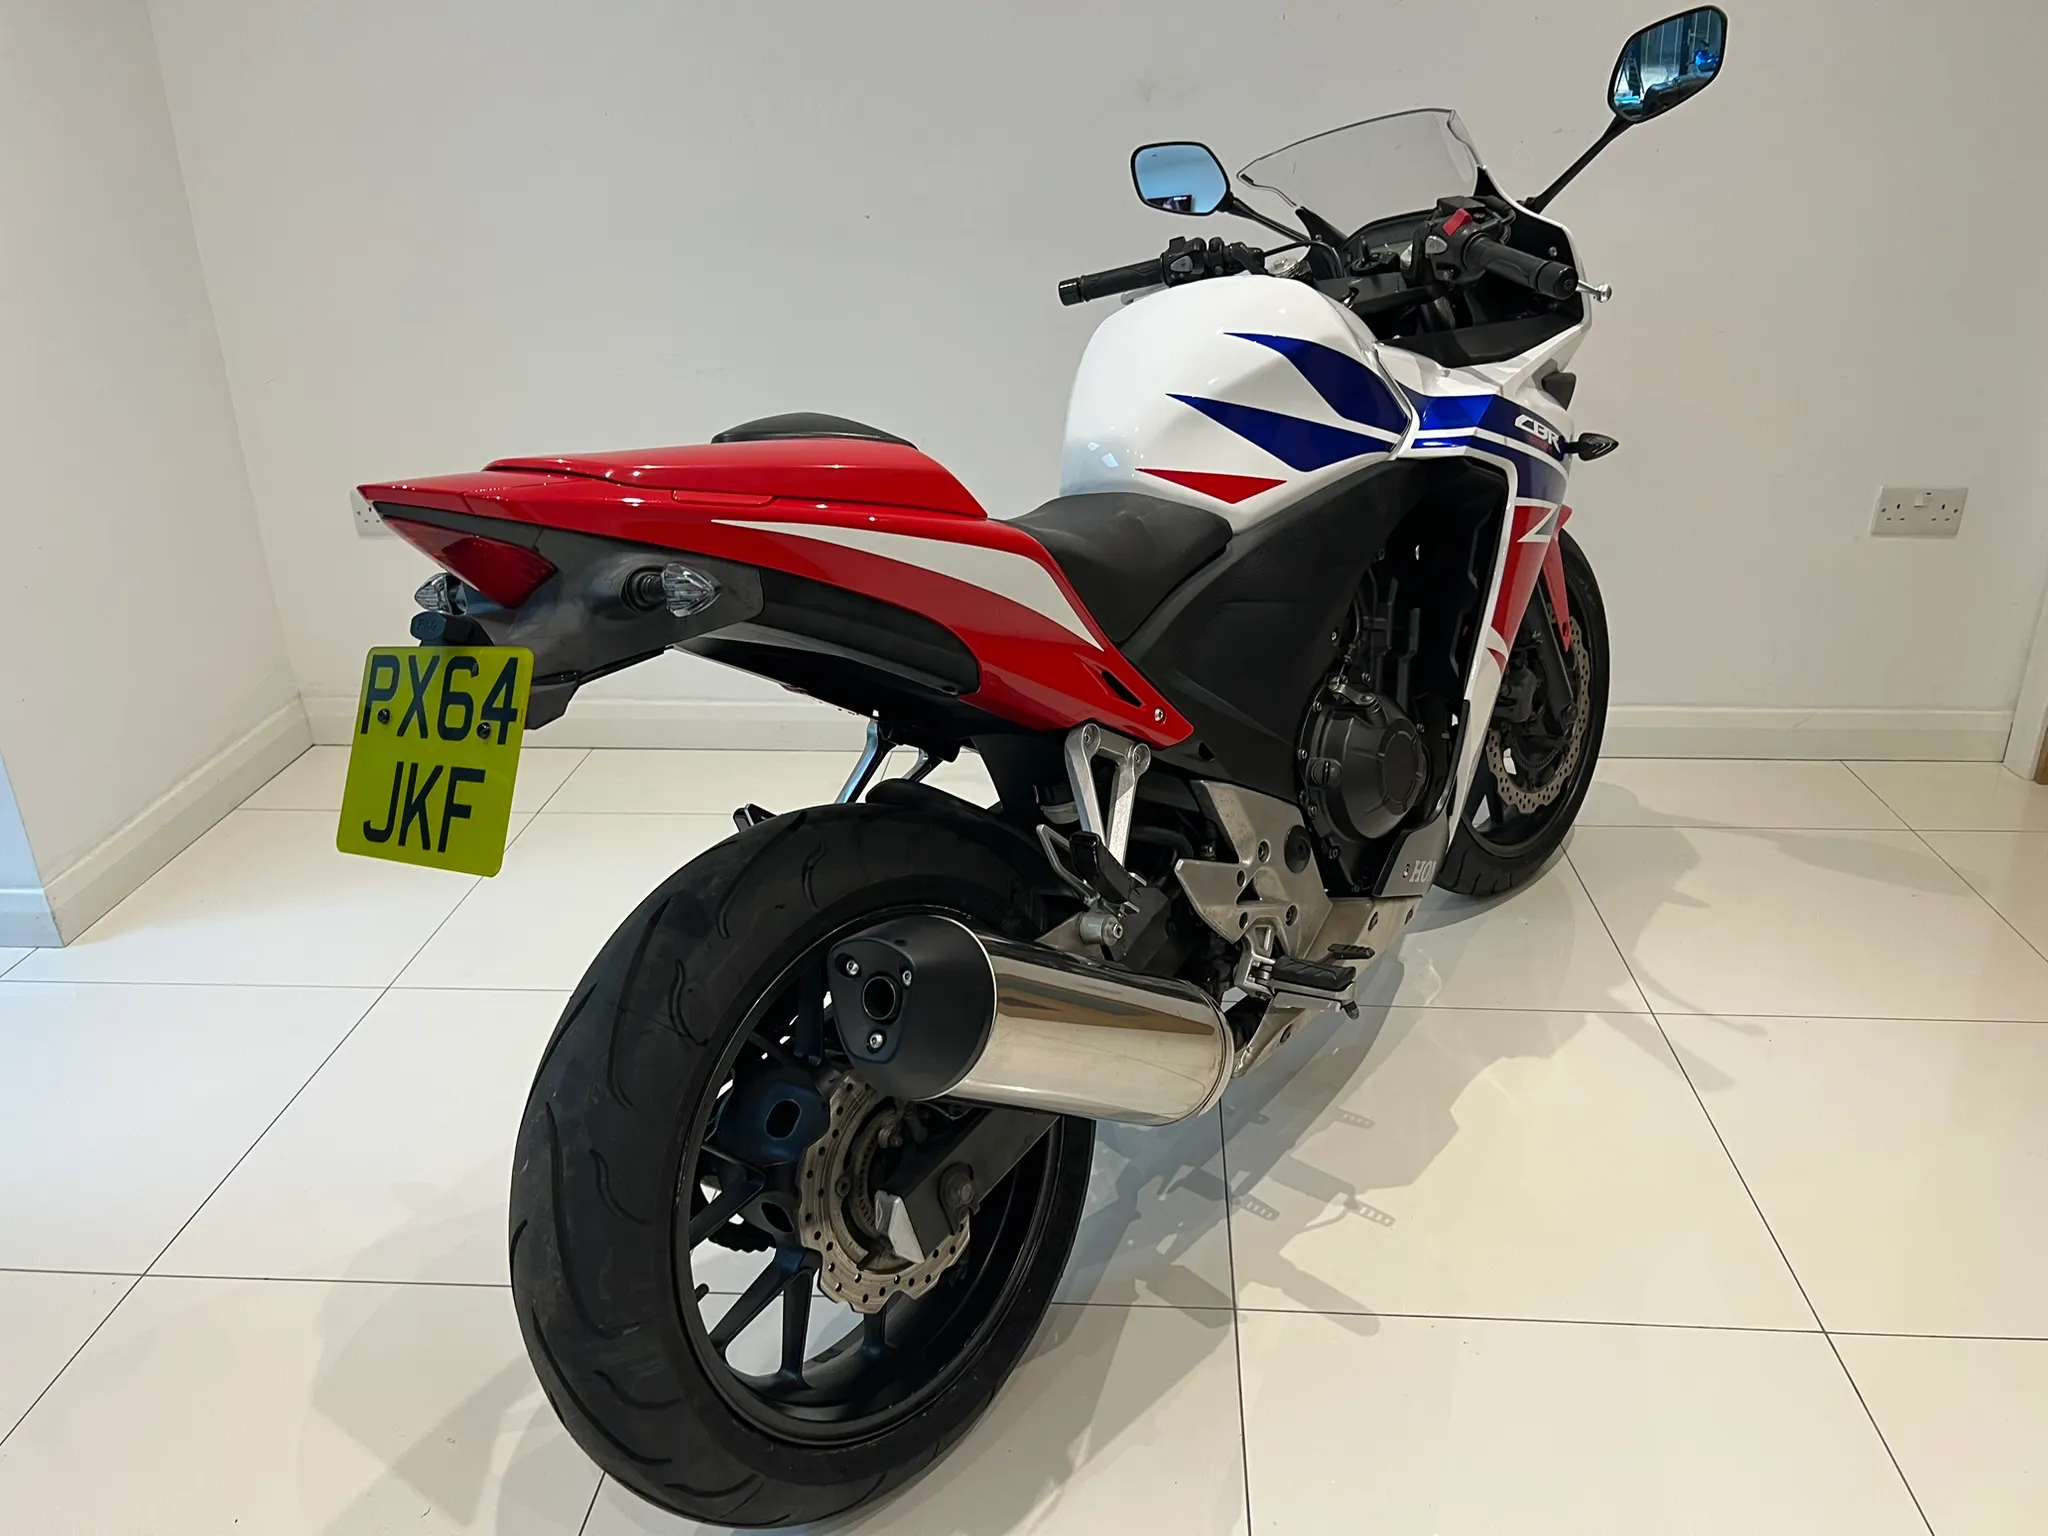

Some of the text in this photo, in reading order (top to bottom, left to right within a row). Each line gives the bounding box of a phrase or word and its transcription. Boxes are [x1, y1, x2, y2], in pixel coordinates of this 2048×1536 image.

[1514, 414, 1561, 453] CBR
[361, 654, 519, 745] PX64
[363, 761, 486, 853] JKF
